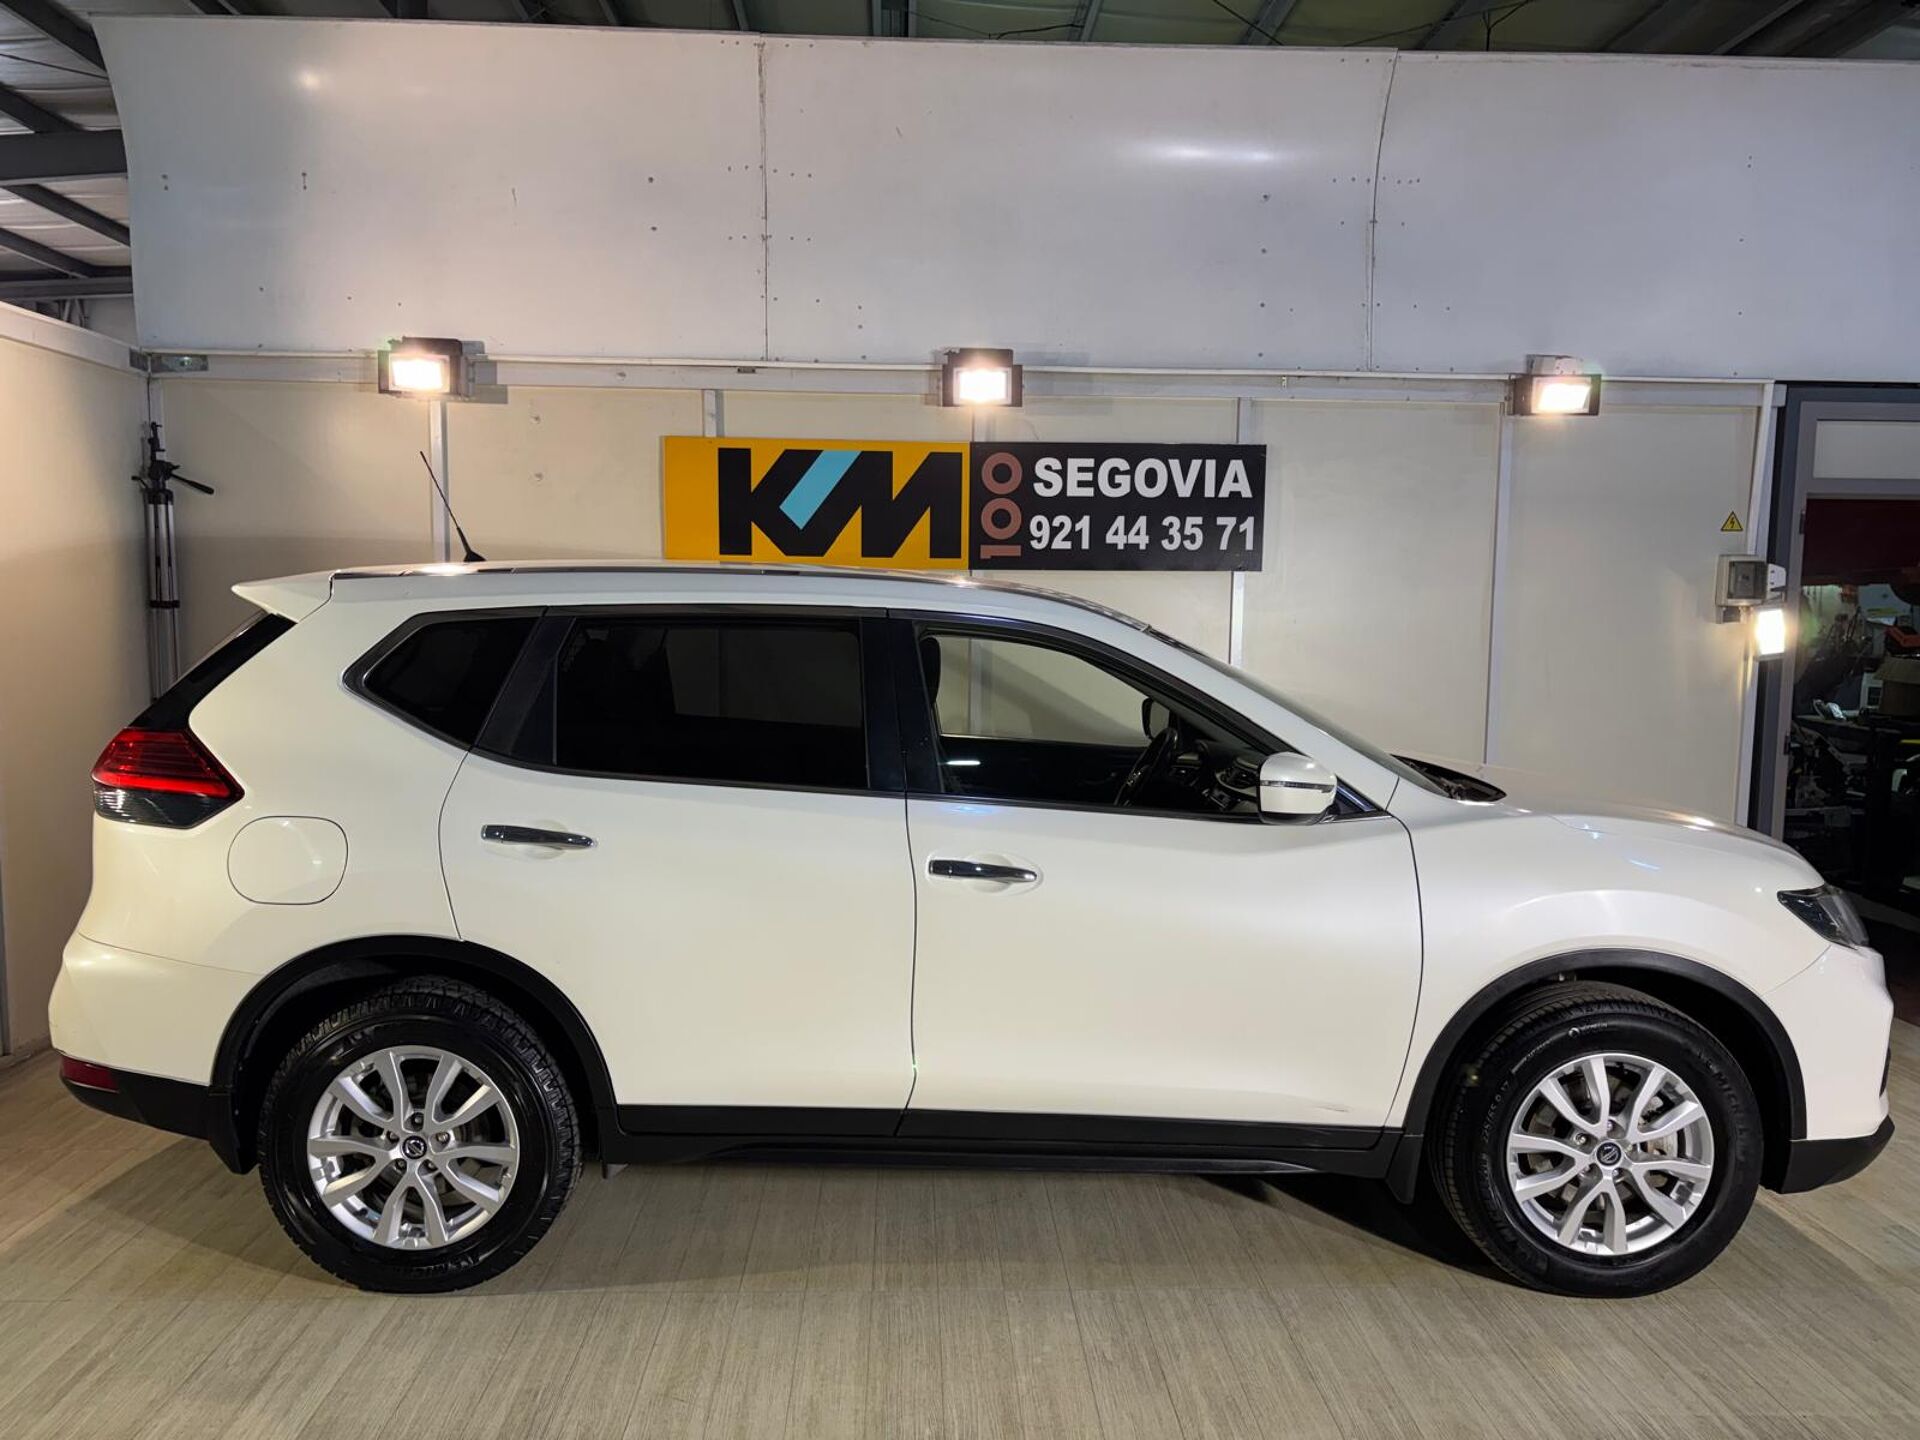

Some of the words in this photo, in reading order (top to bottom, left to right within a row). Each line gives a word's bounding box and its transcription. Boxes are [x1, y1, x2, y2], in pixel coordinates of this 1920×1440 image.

[718, 447, 963, 559] KM
[981, 452, 1022, 559] 100
[1033, 457, 1253, 498] SEGOVIA
[1029, 514, 1090, 550] 921
[1105, 515, 1149, 551] 44
[1161, 515, 1203, 551] 35
[1216, 516, 1255, 551] 71
